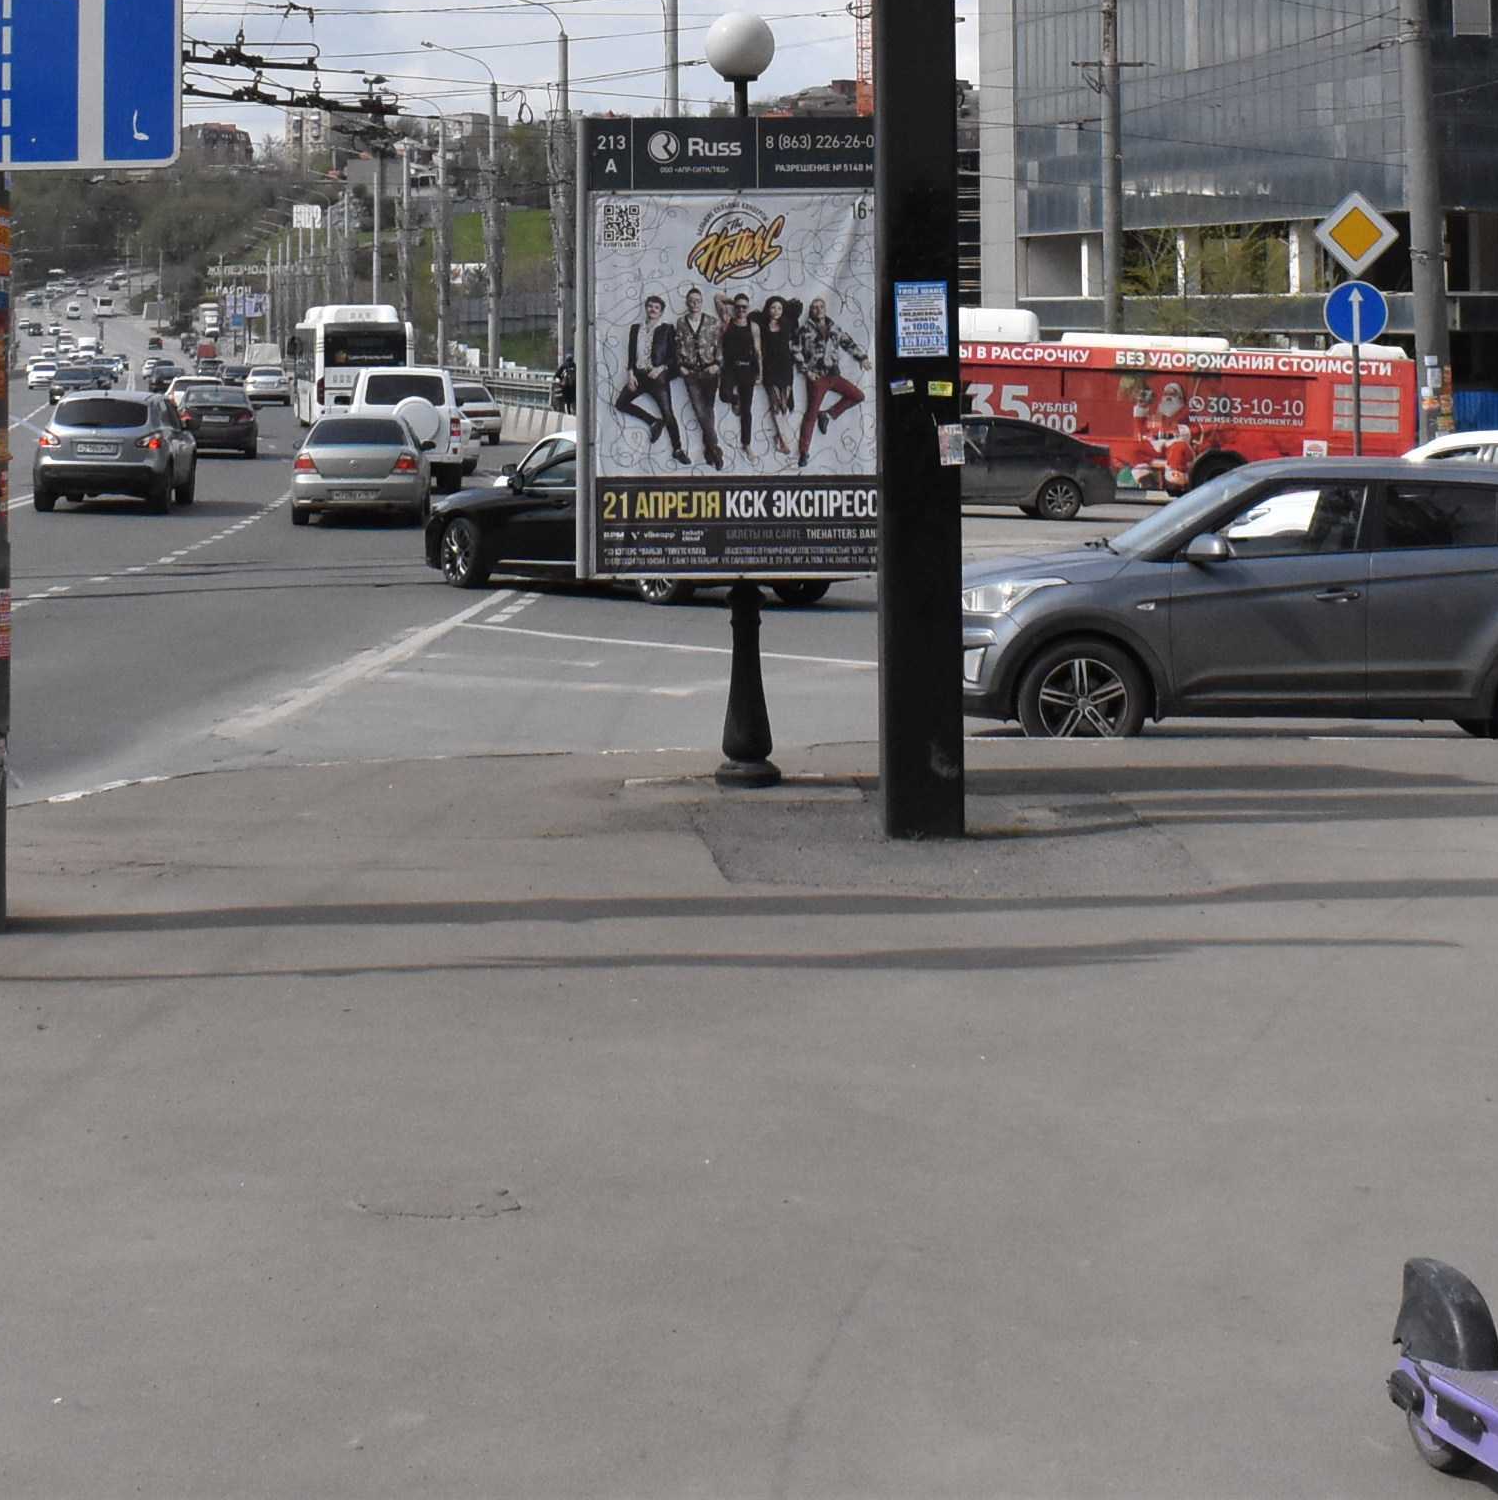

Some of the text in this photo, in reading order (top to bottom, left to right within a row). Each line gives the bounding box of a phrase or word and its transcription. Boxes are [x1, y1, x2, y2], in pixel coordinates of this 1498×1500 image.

[597, 135, 626, 150] 213
[688, 137, 742, 157] Russ
[765, 135, 775, 148] 8
[778, 134, 812, 150] (863)
[977, 346, 987, 359] В
[991, 346, 1090, 363] РАССРОЧКУ
[1115, 351, 1392, 377] БЕЗ УДОРОЖАНИЯ СТОИМОСТИ
[1031, 401, 1078, 414] РУБЛЕЙ
[1207, 396, 1304, 416] 303-10-10
[602, 491, 629, 519] 21
[635, 490, 721, 519] АПРЕЛЯ
[725, 490, 768, 518] КСК
